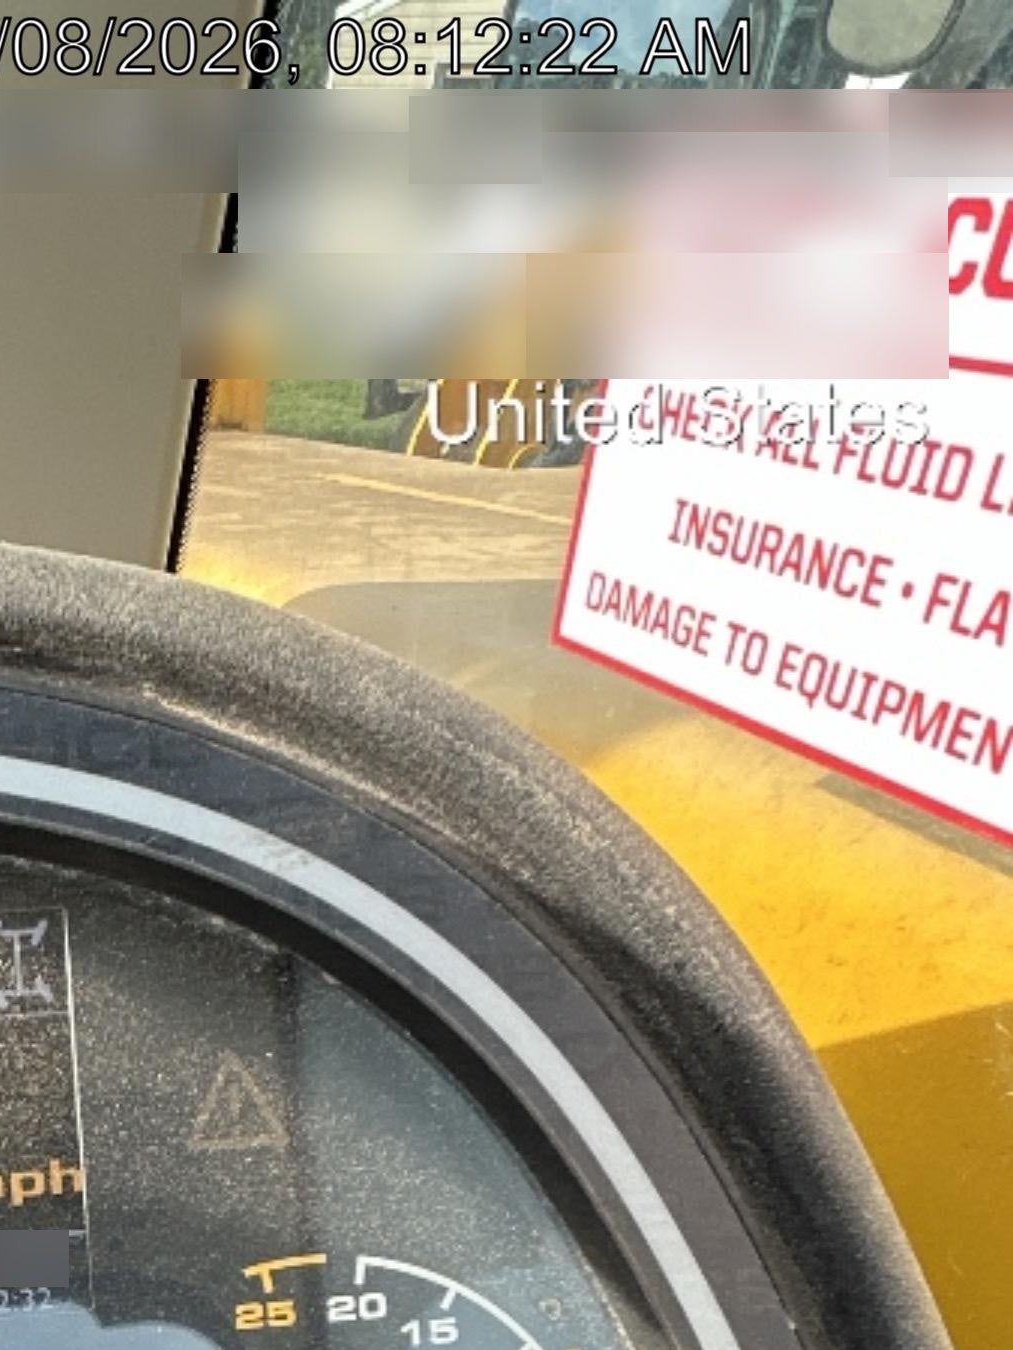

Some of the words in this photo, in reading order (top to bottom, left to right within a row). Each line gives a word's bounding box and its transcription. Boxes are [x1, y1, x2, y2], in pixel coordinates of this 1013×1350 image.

[832, 418, 975, 502] FLUID
[668, 498, 894, 608] INSURANCE
[923, 572, 1011, 648] FLA
[585, 571, 718, 657] DAMAGE
[724, 621, 770, 677] TO
[775, 642, 1013, 776] EQUIPMEN
[235, 1301, 297, 1330] 25
[326, 1293, 388, 1324] 20
[400, 1316, 460, 1347] 15
